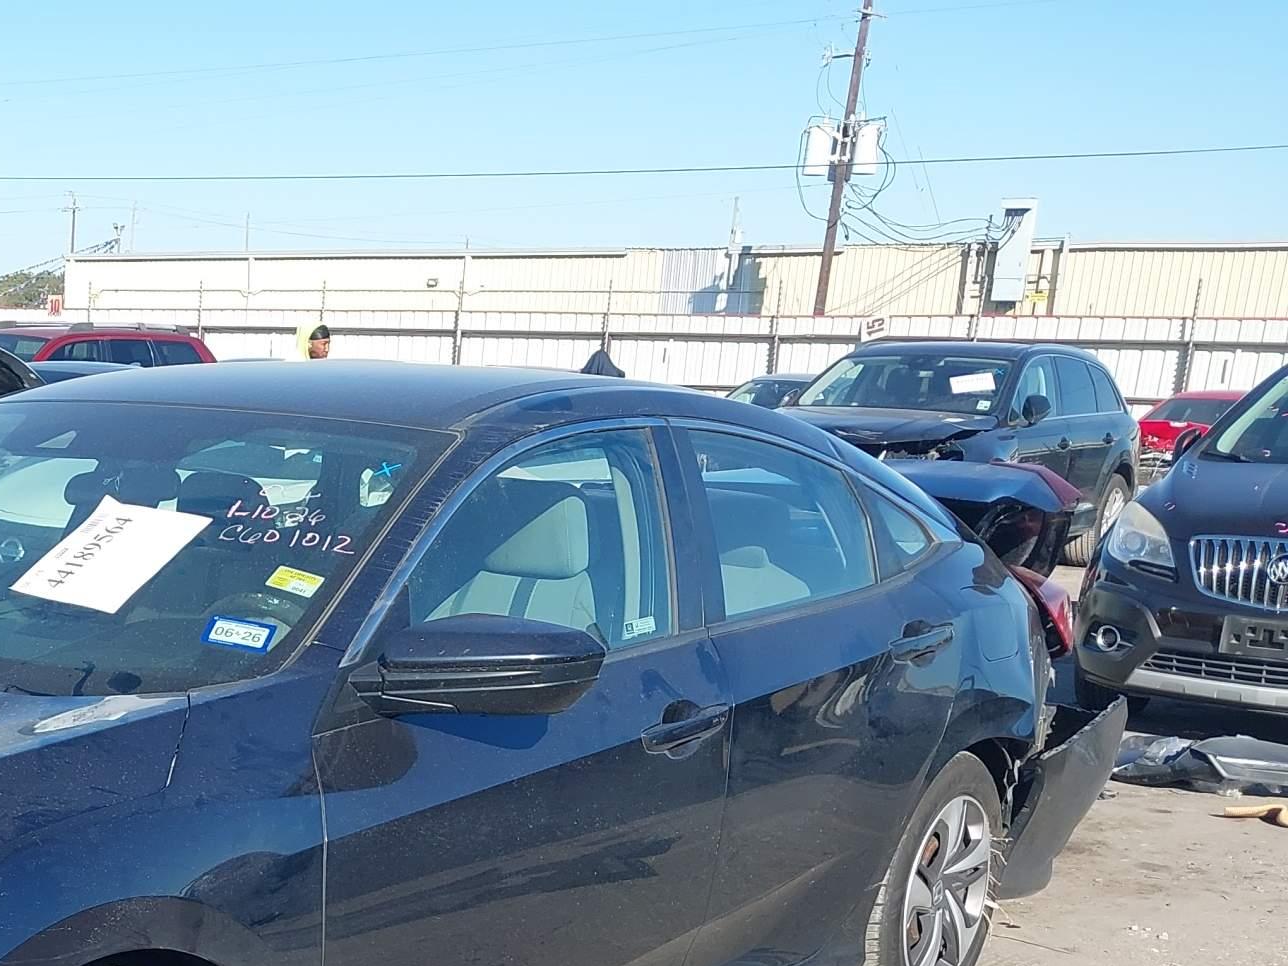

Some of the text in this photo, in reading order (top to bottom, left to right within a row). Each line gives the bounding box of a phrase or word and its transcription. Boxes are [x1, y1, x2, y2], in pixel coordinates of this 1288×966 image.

[50, 299, 60, 313] 10
[866, 317, 885, 337] 15
[47, 517, 134, 589] 44189564
